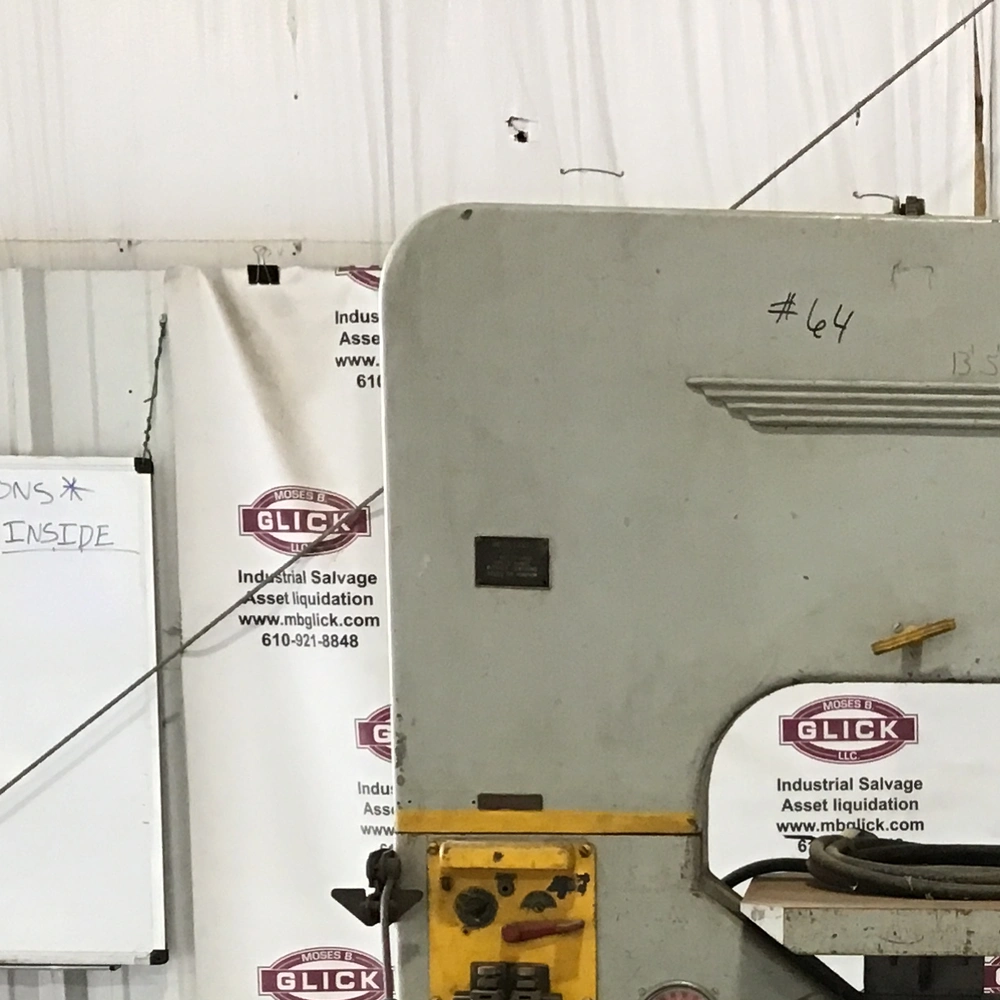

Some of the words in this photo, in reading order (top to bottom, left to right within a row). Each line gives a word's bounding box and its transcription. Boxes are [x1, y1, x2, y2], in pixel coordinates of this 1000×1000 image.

[335, 309, 379, 324] Indus
[768, 292, 854, 343] #64
[339, 331, 380, 346] Asse
[274, 490, 314, 501] MOSES
[257, 511, 350, 532] GLICK
[3, 521, 114, 550] INSIDE
[311, 570, 378, 588] Salvage
[243, 591, 290, 605] Asset
[292, 592, 373, 609] liquidation
[239, 612, 380, 630] www.mbglick.com
[262, 633, 359, 648] 610-921-8848
[823, 700, 861, 711] MOSES
[798, 720, 899, 739] GLICK
[777, 777, 853, 791] Industrial
[859, 777, 923, 793] Salvage
[363, 802, 394, 816] Ass
[781, 798, 828, 812] Asset
[833, 798, 918, 814] liquidation
[301, 951, 341, 962] MOSES
[277, 971, 380, 990] GLICK
